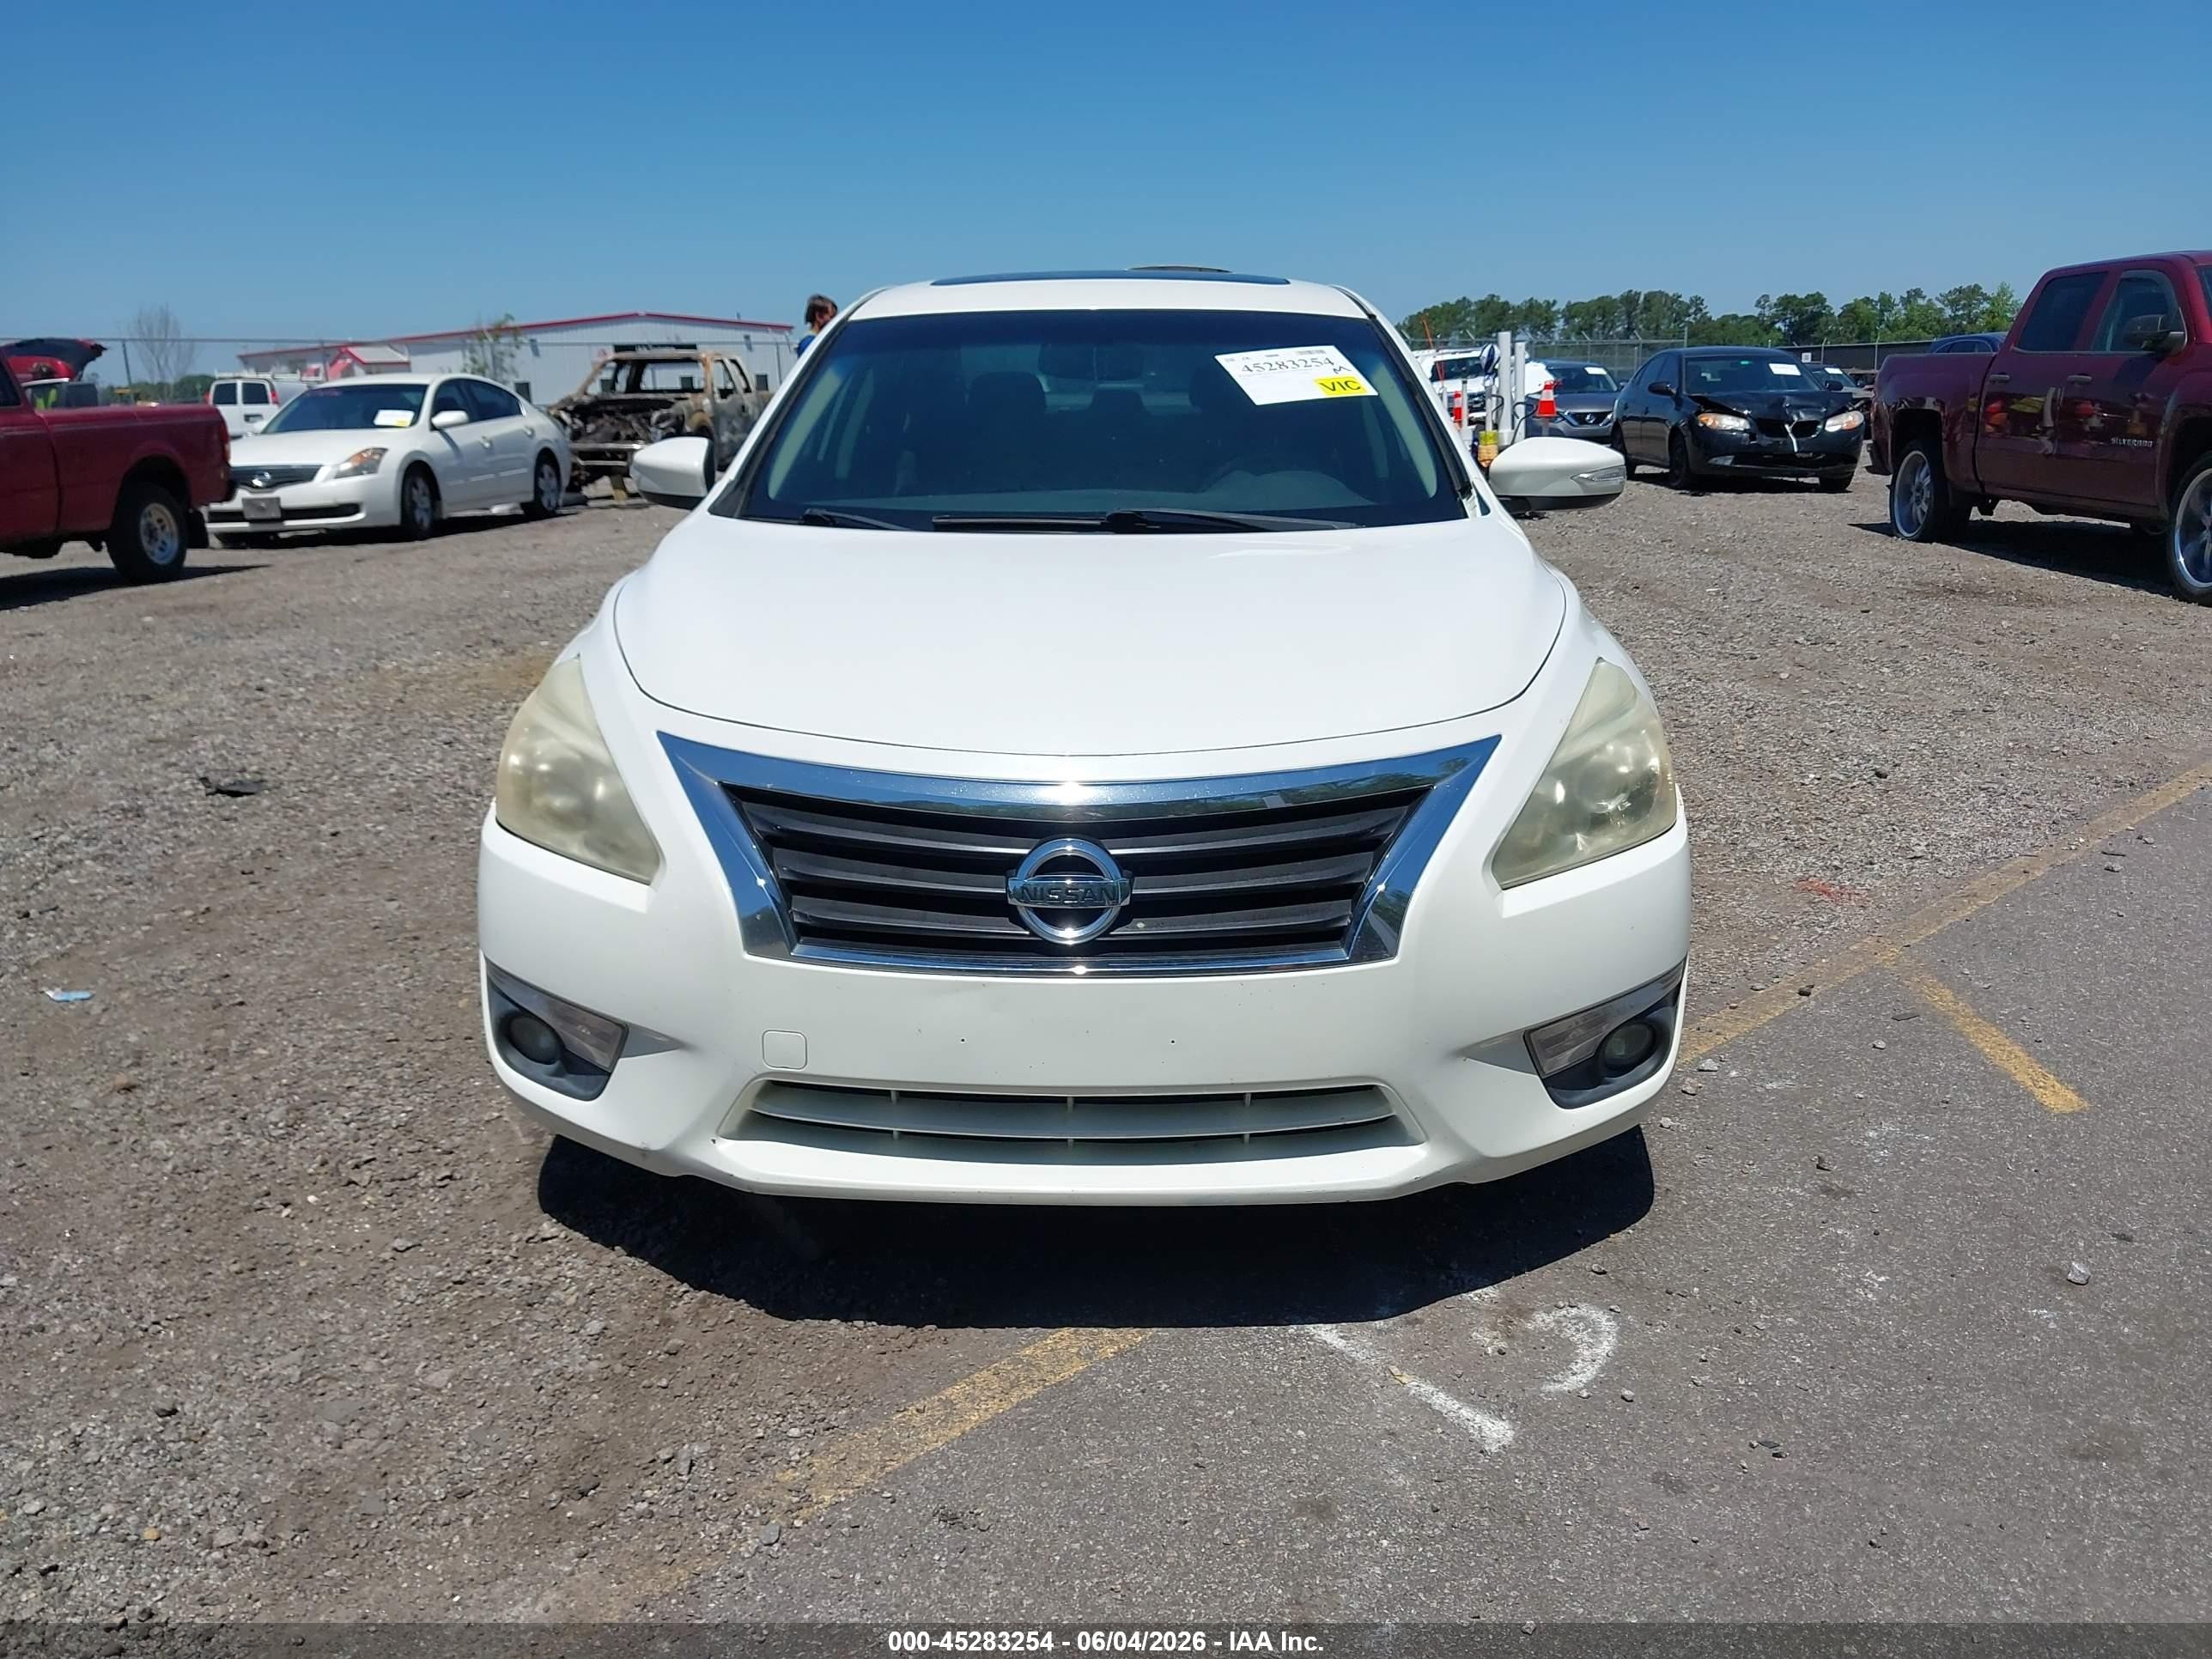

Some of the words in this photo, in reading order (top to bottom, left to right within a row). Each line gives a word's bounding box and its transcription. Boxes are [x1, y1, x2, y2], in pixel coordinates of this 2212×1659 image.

[1242, 356, 1334, 373] 45283254
[1319, 380, 1362, 392] VIC
[1021, 884, 1117, 904] NISSAN
